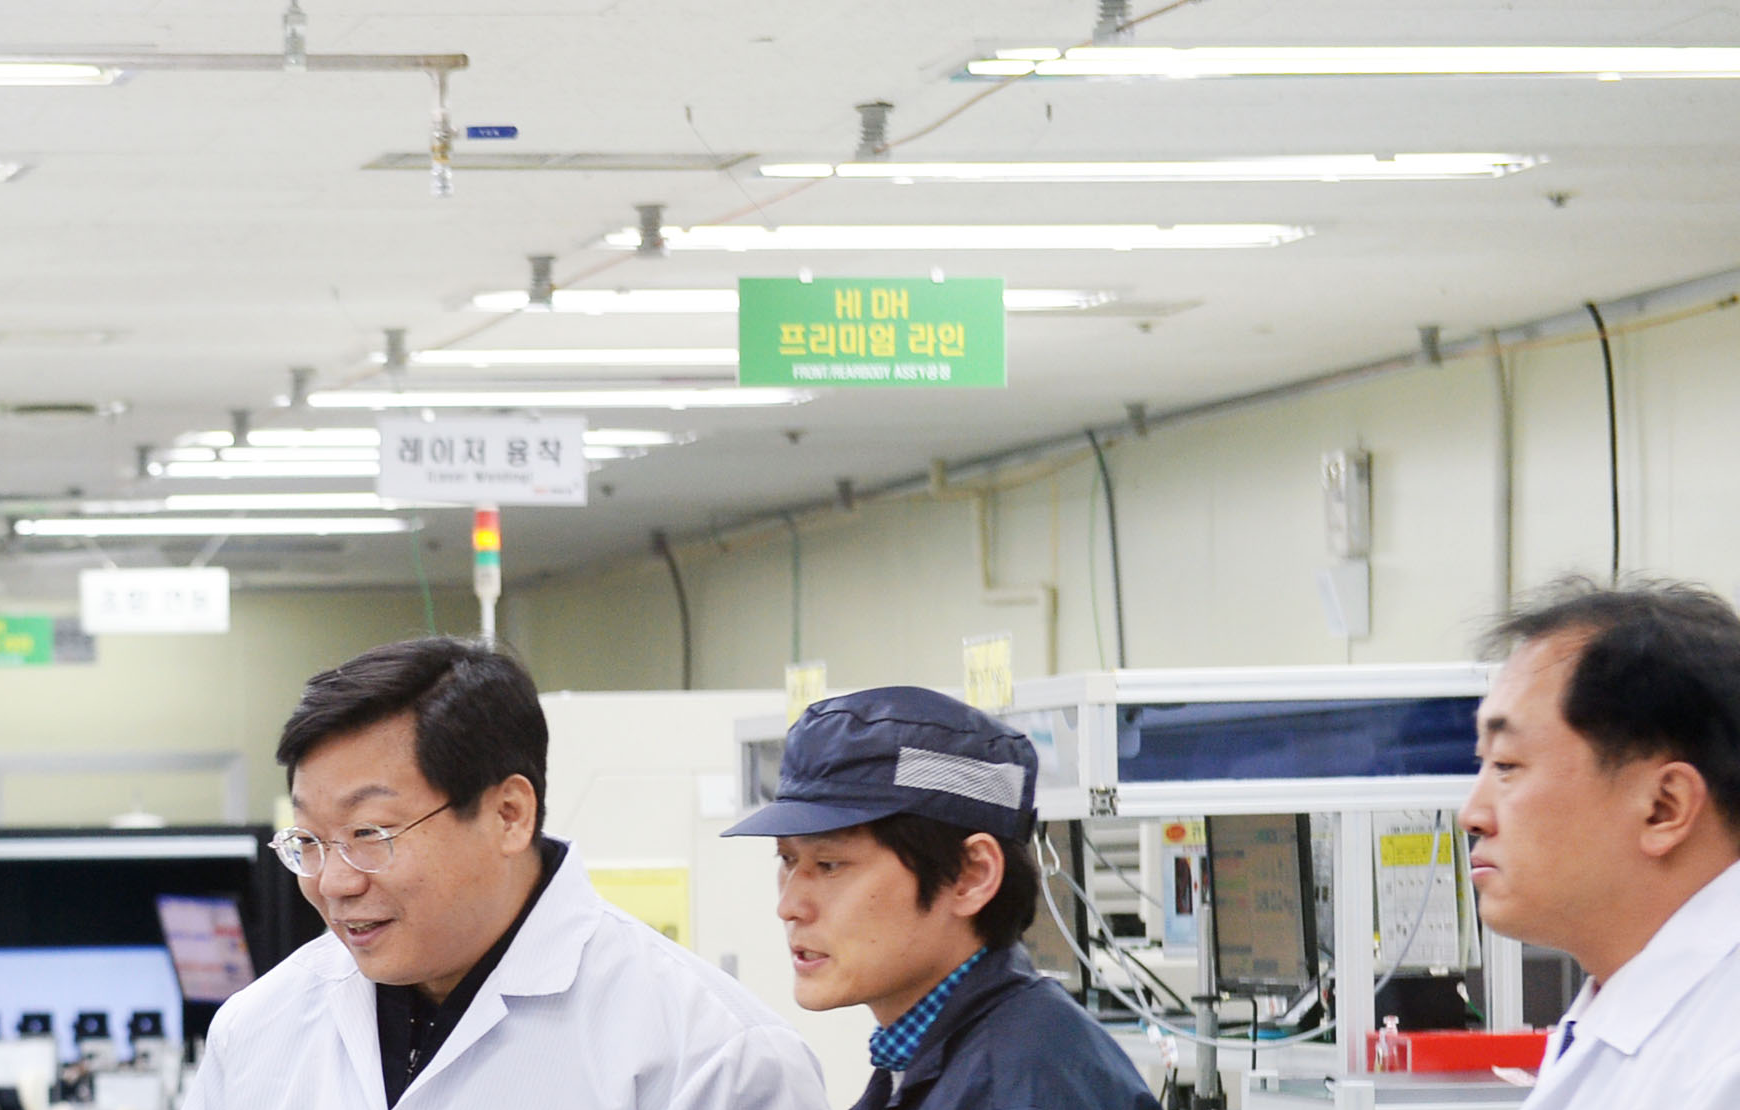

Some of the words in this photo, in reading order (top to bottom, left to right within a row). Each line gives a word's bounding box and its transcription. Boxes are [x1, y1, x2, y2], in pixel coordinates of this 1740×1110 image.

[834, 288, 862, 319] HI
[871, 288, 908, 319] DH
[779, 323, 896, 357] 프리미엄
[908, 323, 965, 357] 라인
[398, 435, 486, 466] 레이저
